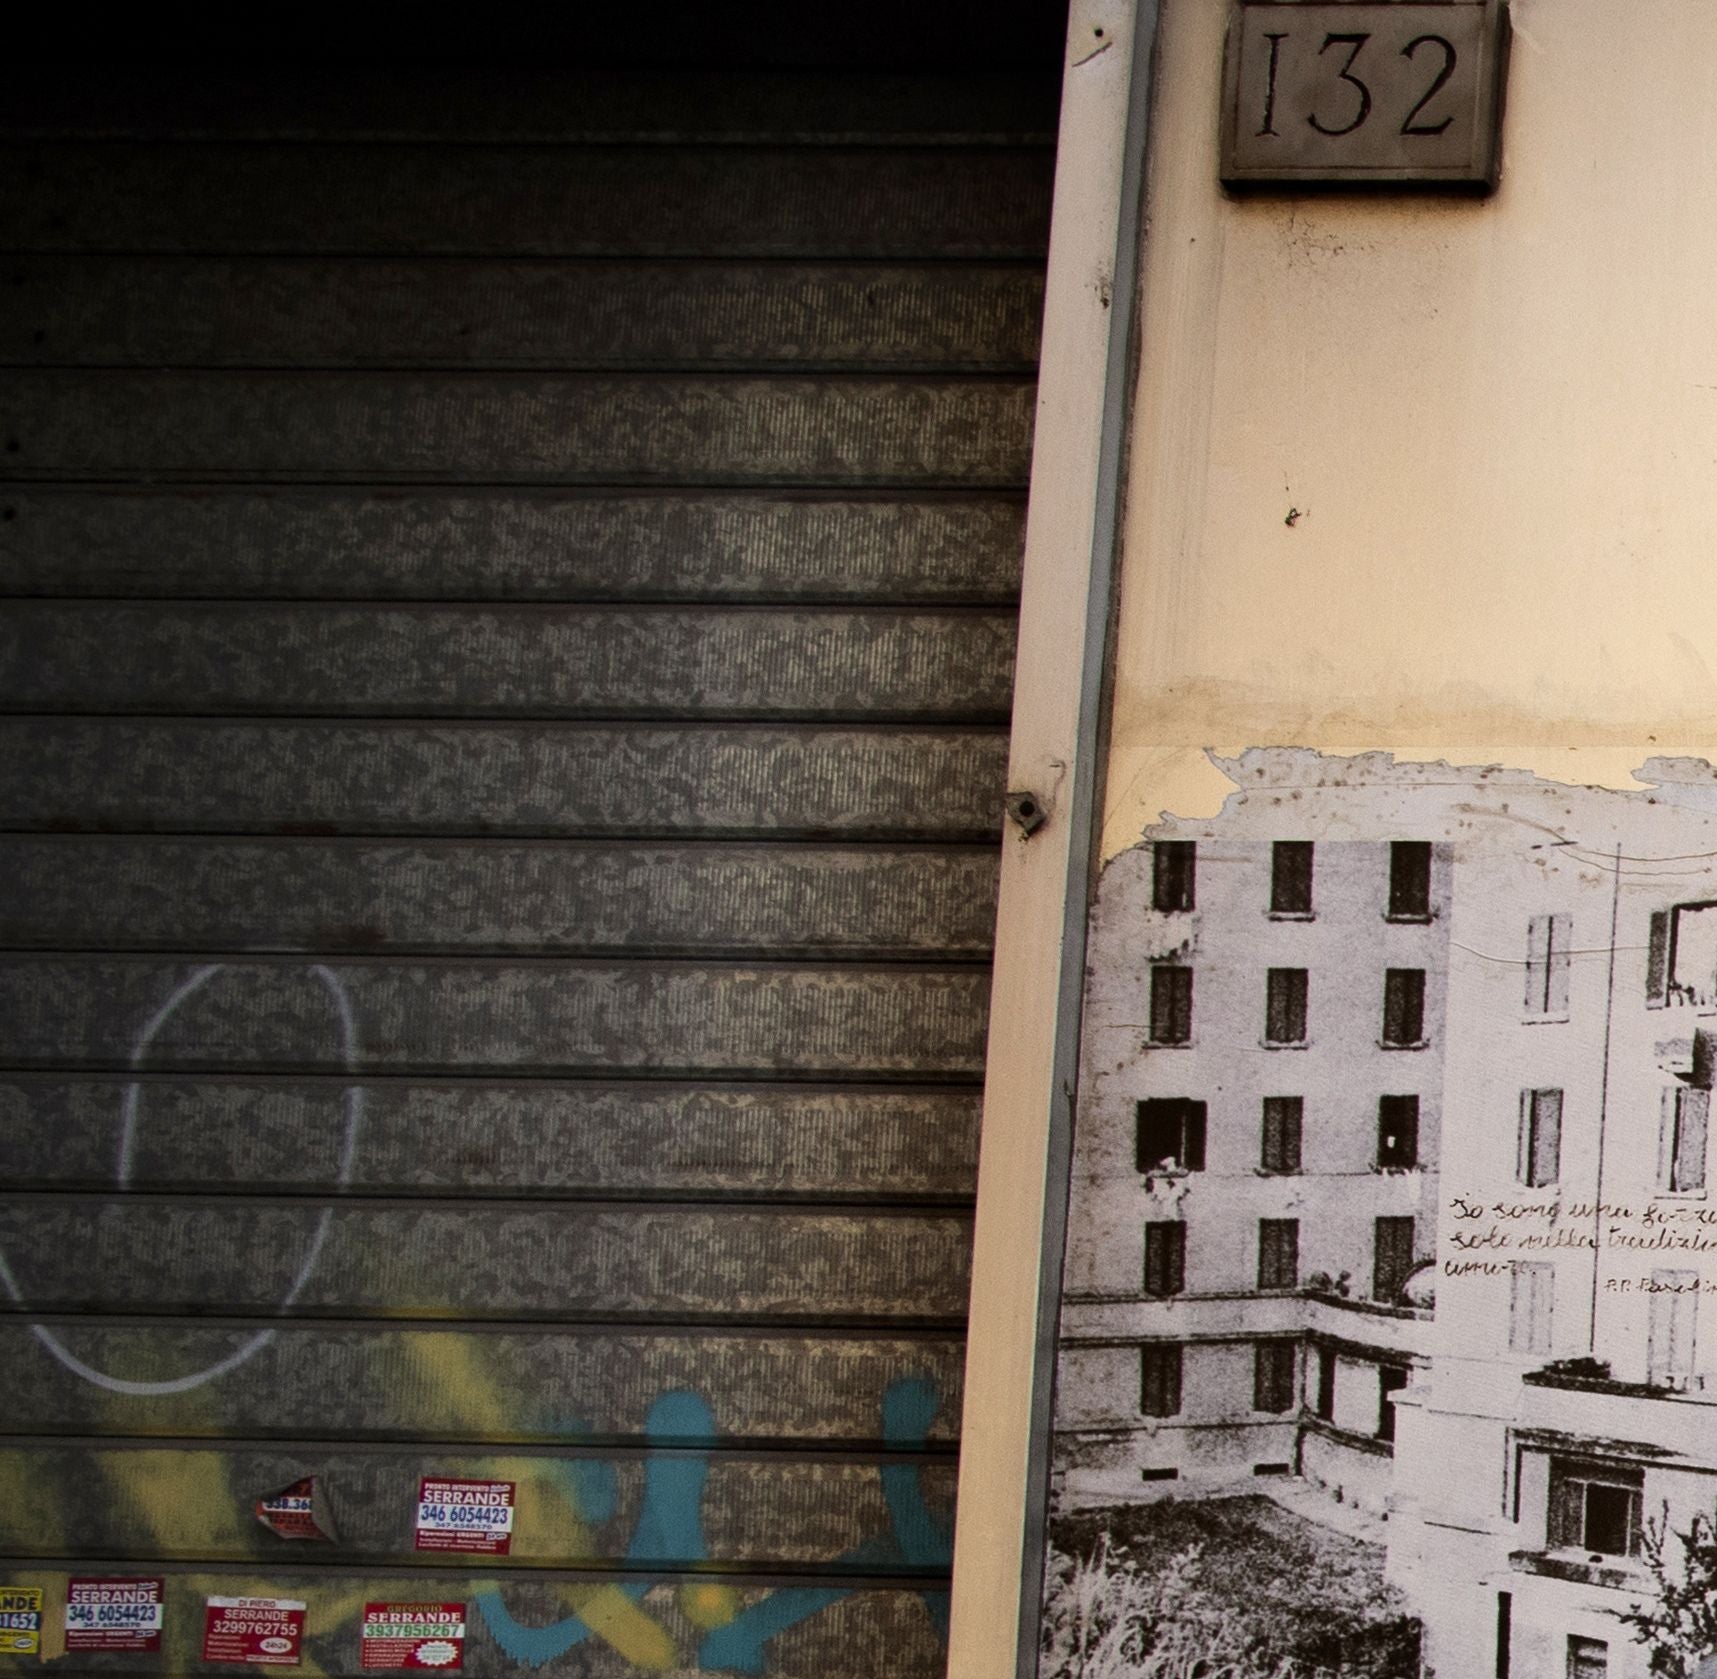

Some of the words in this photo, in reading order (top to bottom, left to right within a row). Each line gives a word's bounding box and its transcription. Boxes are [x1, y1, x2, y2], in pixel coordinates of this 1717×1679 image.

[1255, 33, 1457, 137] 132
[1568, 1203, 1632, 1218] una
[1450, 1230, 1512, 1251] solo
[1519, 1229, 1599, 1249] nella
[424, 1491, 510, 1506] SERRANDE
[421, 1505, 446, 1522] 346
[450, 1507, 508, 1525] 6054423
[71, 1590, 158, 1604] SERRANDE
[69, 1605, 95, 1622] 346
[98, 1605, 156, 1622] 6054423
[224, 1609, 289, 1622] SERRANDE
[367, 1612, 461, 1624] SERRANDE
[212, 1620, 298, 1636] 3299762755
[366, 1625, 460, 1637] 3937956267
